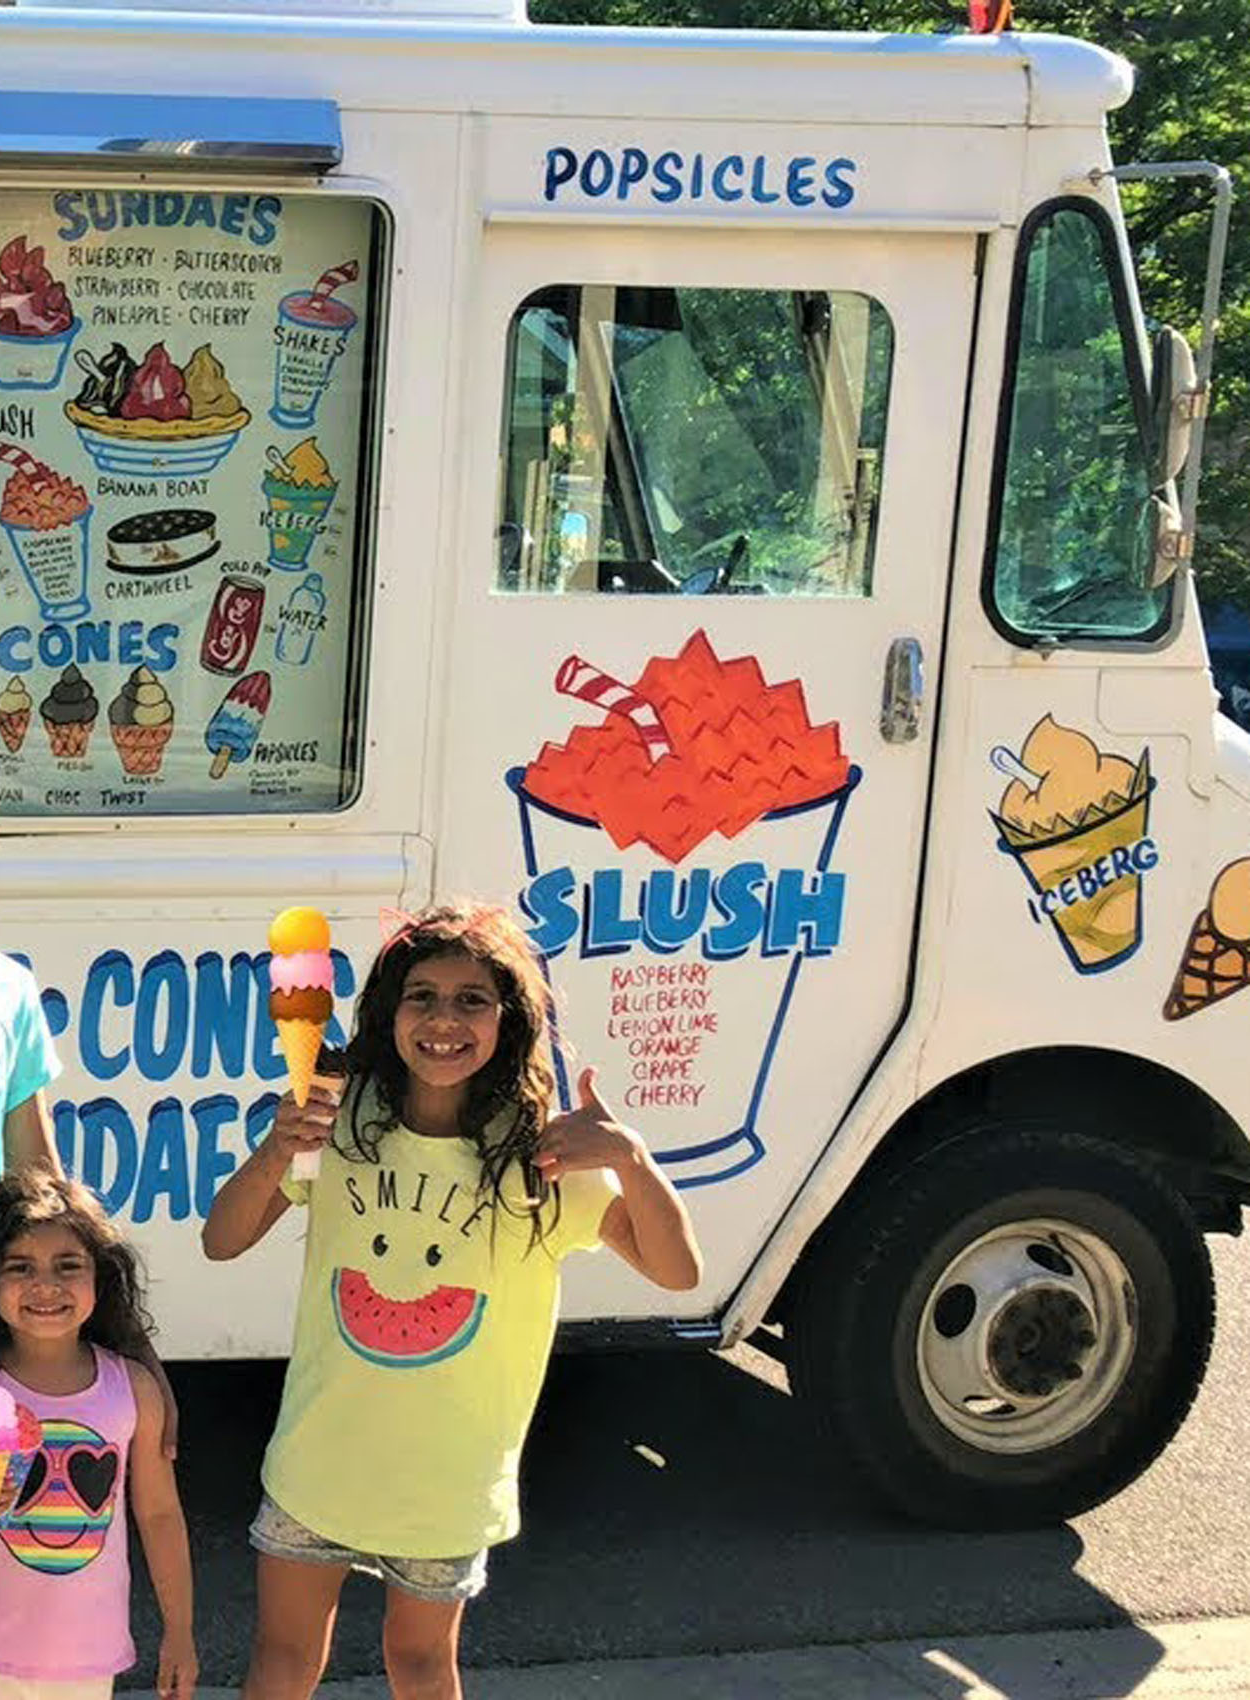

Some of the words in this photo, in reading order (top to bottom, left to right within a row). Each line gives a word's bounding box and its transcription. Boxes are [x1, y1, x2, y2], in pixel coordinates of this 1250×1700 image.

[544, 147, 856, 208] POPSICLES
[53, 190, 282, 246] SUNDAES
[67, 247, 155, 269] BLUEBERRY
[174, 250, 282, 274] BUTTERSCOTCH
[74, 276, 160, 299] STRAWBERRY
[178, 280, 256, 301] CHOCOLATE
[92, 305, 171, 327] PINEAPPLE
[189, 306, 251, 327] CHERRY
[273, 325, 347, 356] SHAKES
[97, 477, 158, 497] BANANA
[166, 479, 209, 497] BOAT
[105, 576, 195, 600] CARTWHEEL
[279, 604, 327, 631] WATER
[46, 788, 81, 806] CHOC
[101, 788, 147, 806] TWIST
[1027, 839, 1159, 924] ICEBERG
[519, 862, 846, 960] SLUSH
[611, 963, 713, 990] RASPBERRY
[611, 988, 711, 1015] BLUEBERRY
[608, 1014, 674, 1039] LEMON
[678, 1012, 718, 1033] LIME
[628, 1036, 702, 1057] ORANGE
[632, 1059, 694, 1081] GRAPE
[624, 1083, 706, 1107] CHERRY
[345, 1170, 494, 1237] SMILE
